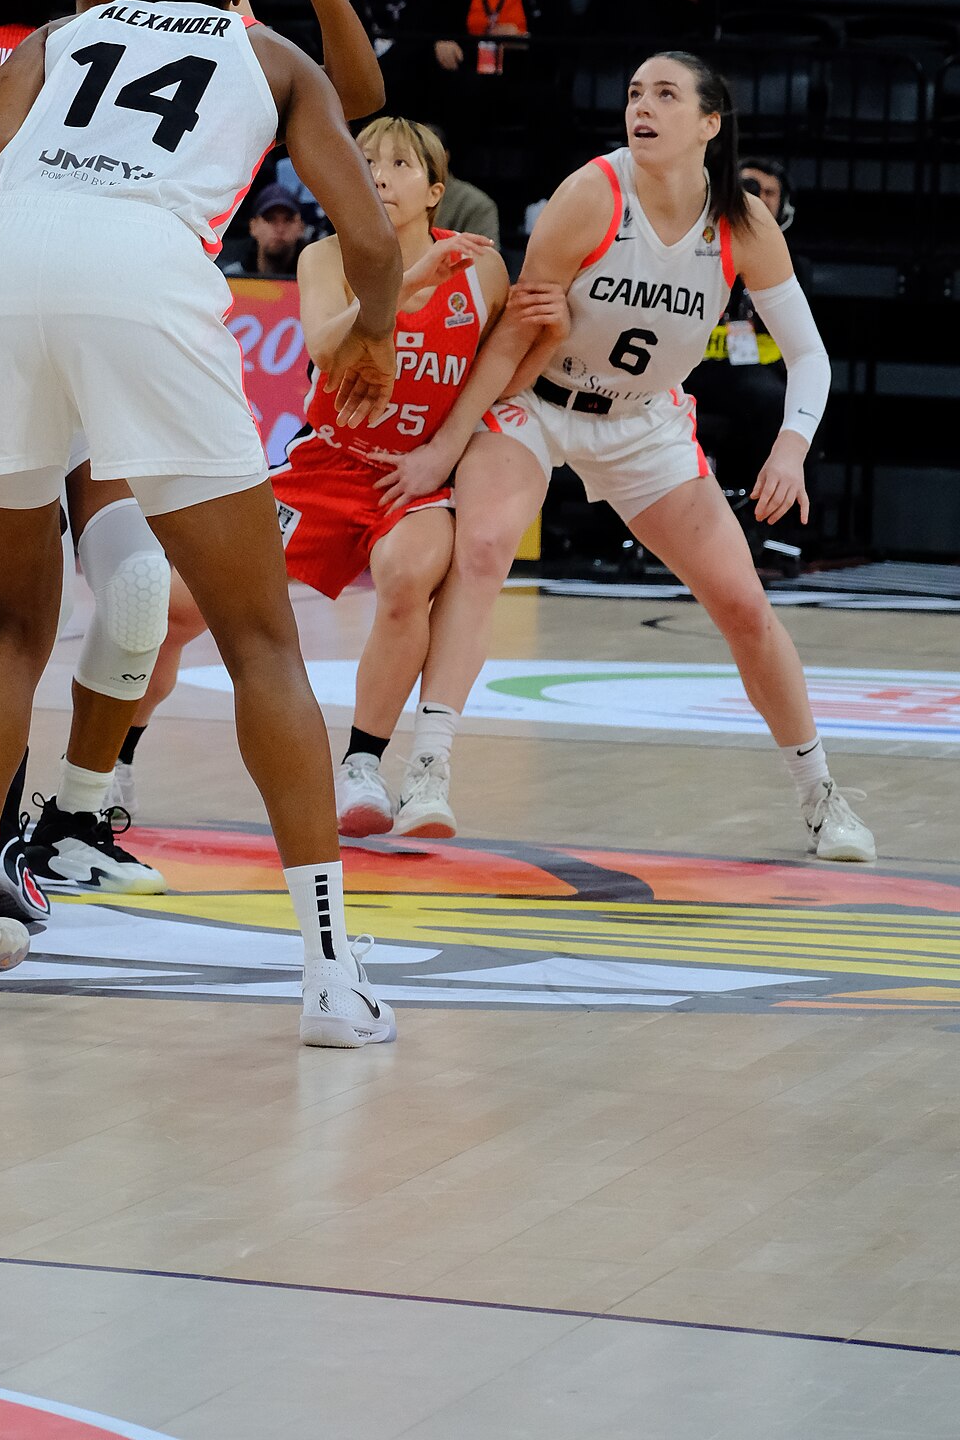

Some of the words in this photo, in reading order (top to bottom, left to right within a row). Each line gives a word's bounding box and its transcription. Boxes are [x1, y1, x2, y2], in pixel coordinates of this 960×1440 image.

[99, 6, 232, 37] ALEXANDER
[64, 41, 218, 153] 14
[589, 277, 705, 320] CANADA
[395, 351, 467, 386] PAN
[609, 328, 658, 376] 6
